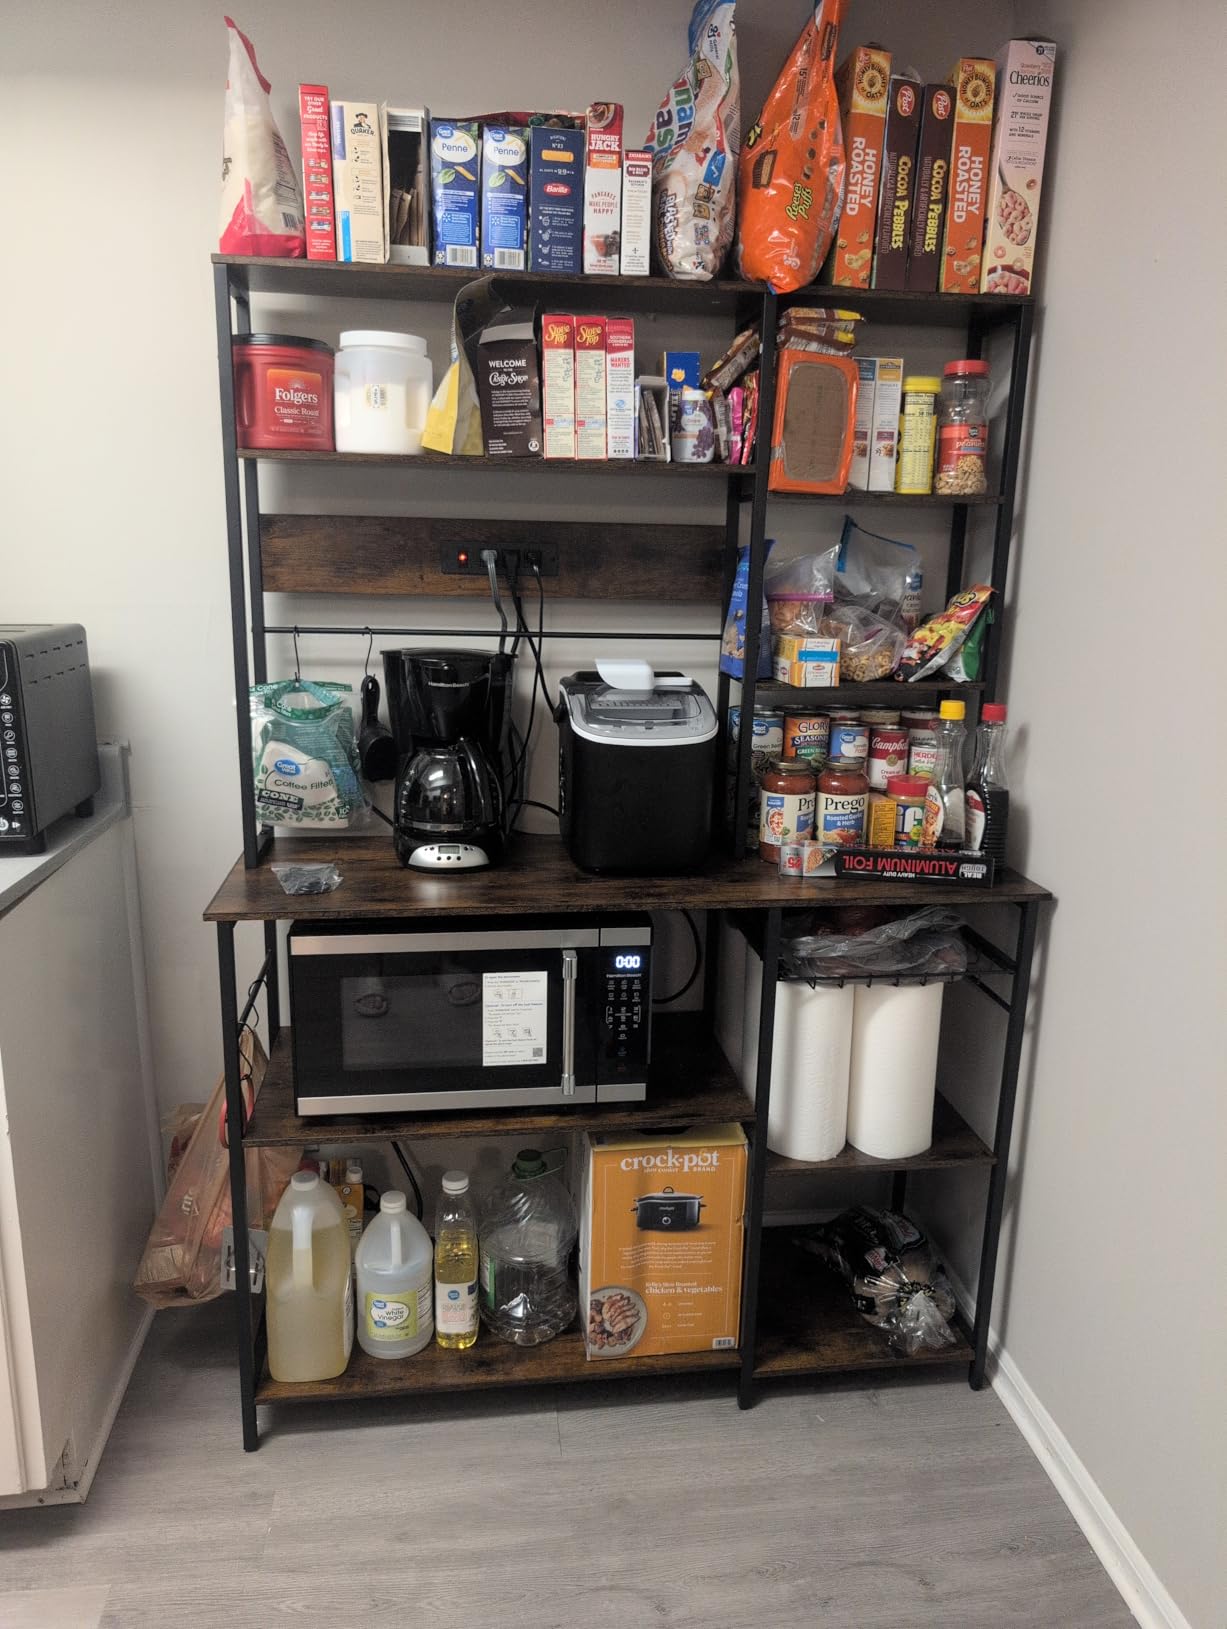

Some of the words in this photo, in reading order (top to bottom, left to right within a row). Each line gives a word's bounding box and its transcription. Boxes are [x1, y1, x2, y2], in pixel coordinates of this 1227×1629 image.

[962, 74, 973, 95] HONEY
[1009, 70, 1050, 87] Cheerios
[901, 89, 913, 113] Post
[936, 94, 948, 116] Post
[970, 99, 988, 108] OATS
[350, 127, 375, 136] QUAKER
[590, 133, 620, 142] HUNGRY
[442, 143, 468, 152] Penne
[493, 146, 519, 156] Penne
[589, 140, 621, 151] JACK
[845, 137, 866, 215] ROASTED
[860, 149, 877, 209] HONEY
[896, 155, 912, 197] COCOA
[930, 159, 947, 200] COCOA
[546, 185, 569, 194] Barilla
[953, 146, 972, 223] ROASTED
[967, 156, 984, 216] HONEY
[891, 200, 909, 250] PEBBLES
[925, 203, 943, 252] PEBBLES
[488, 359, 527, 368] WELCOME
[274, 387, 319, 405] Folgers
[274, 406, 301, 416] Classic
[276, 761, 296, 771] Great
[274, 779, 308, 790] Coffee
[261, 789, 300, 803] CONE
[824, 797, 865, 813] Prego
[826, 814, 849, 822] Roasted
[848, 812, 863, 820] Garlic
[896, 806, 924, 833] if
[843, 855, 875, 870] FOIL
[877, 858, 958, 875] ALUMINUM
[961, 865, 987, 873] TOUGH
[962, 872, 983, 880] REAL
[614, 955, 641, 969] 0:00
[645, 1285, 675, 1294] chicken
[683, 1285, 723, 1294] vegetables
[377, 1312, 405, 1322] Vinegar
[385, 1308, 404, 1317] White
